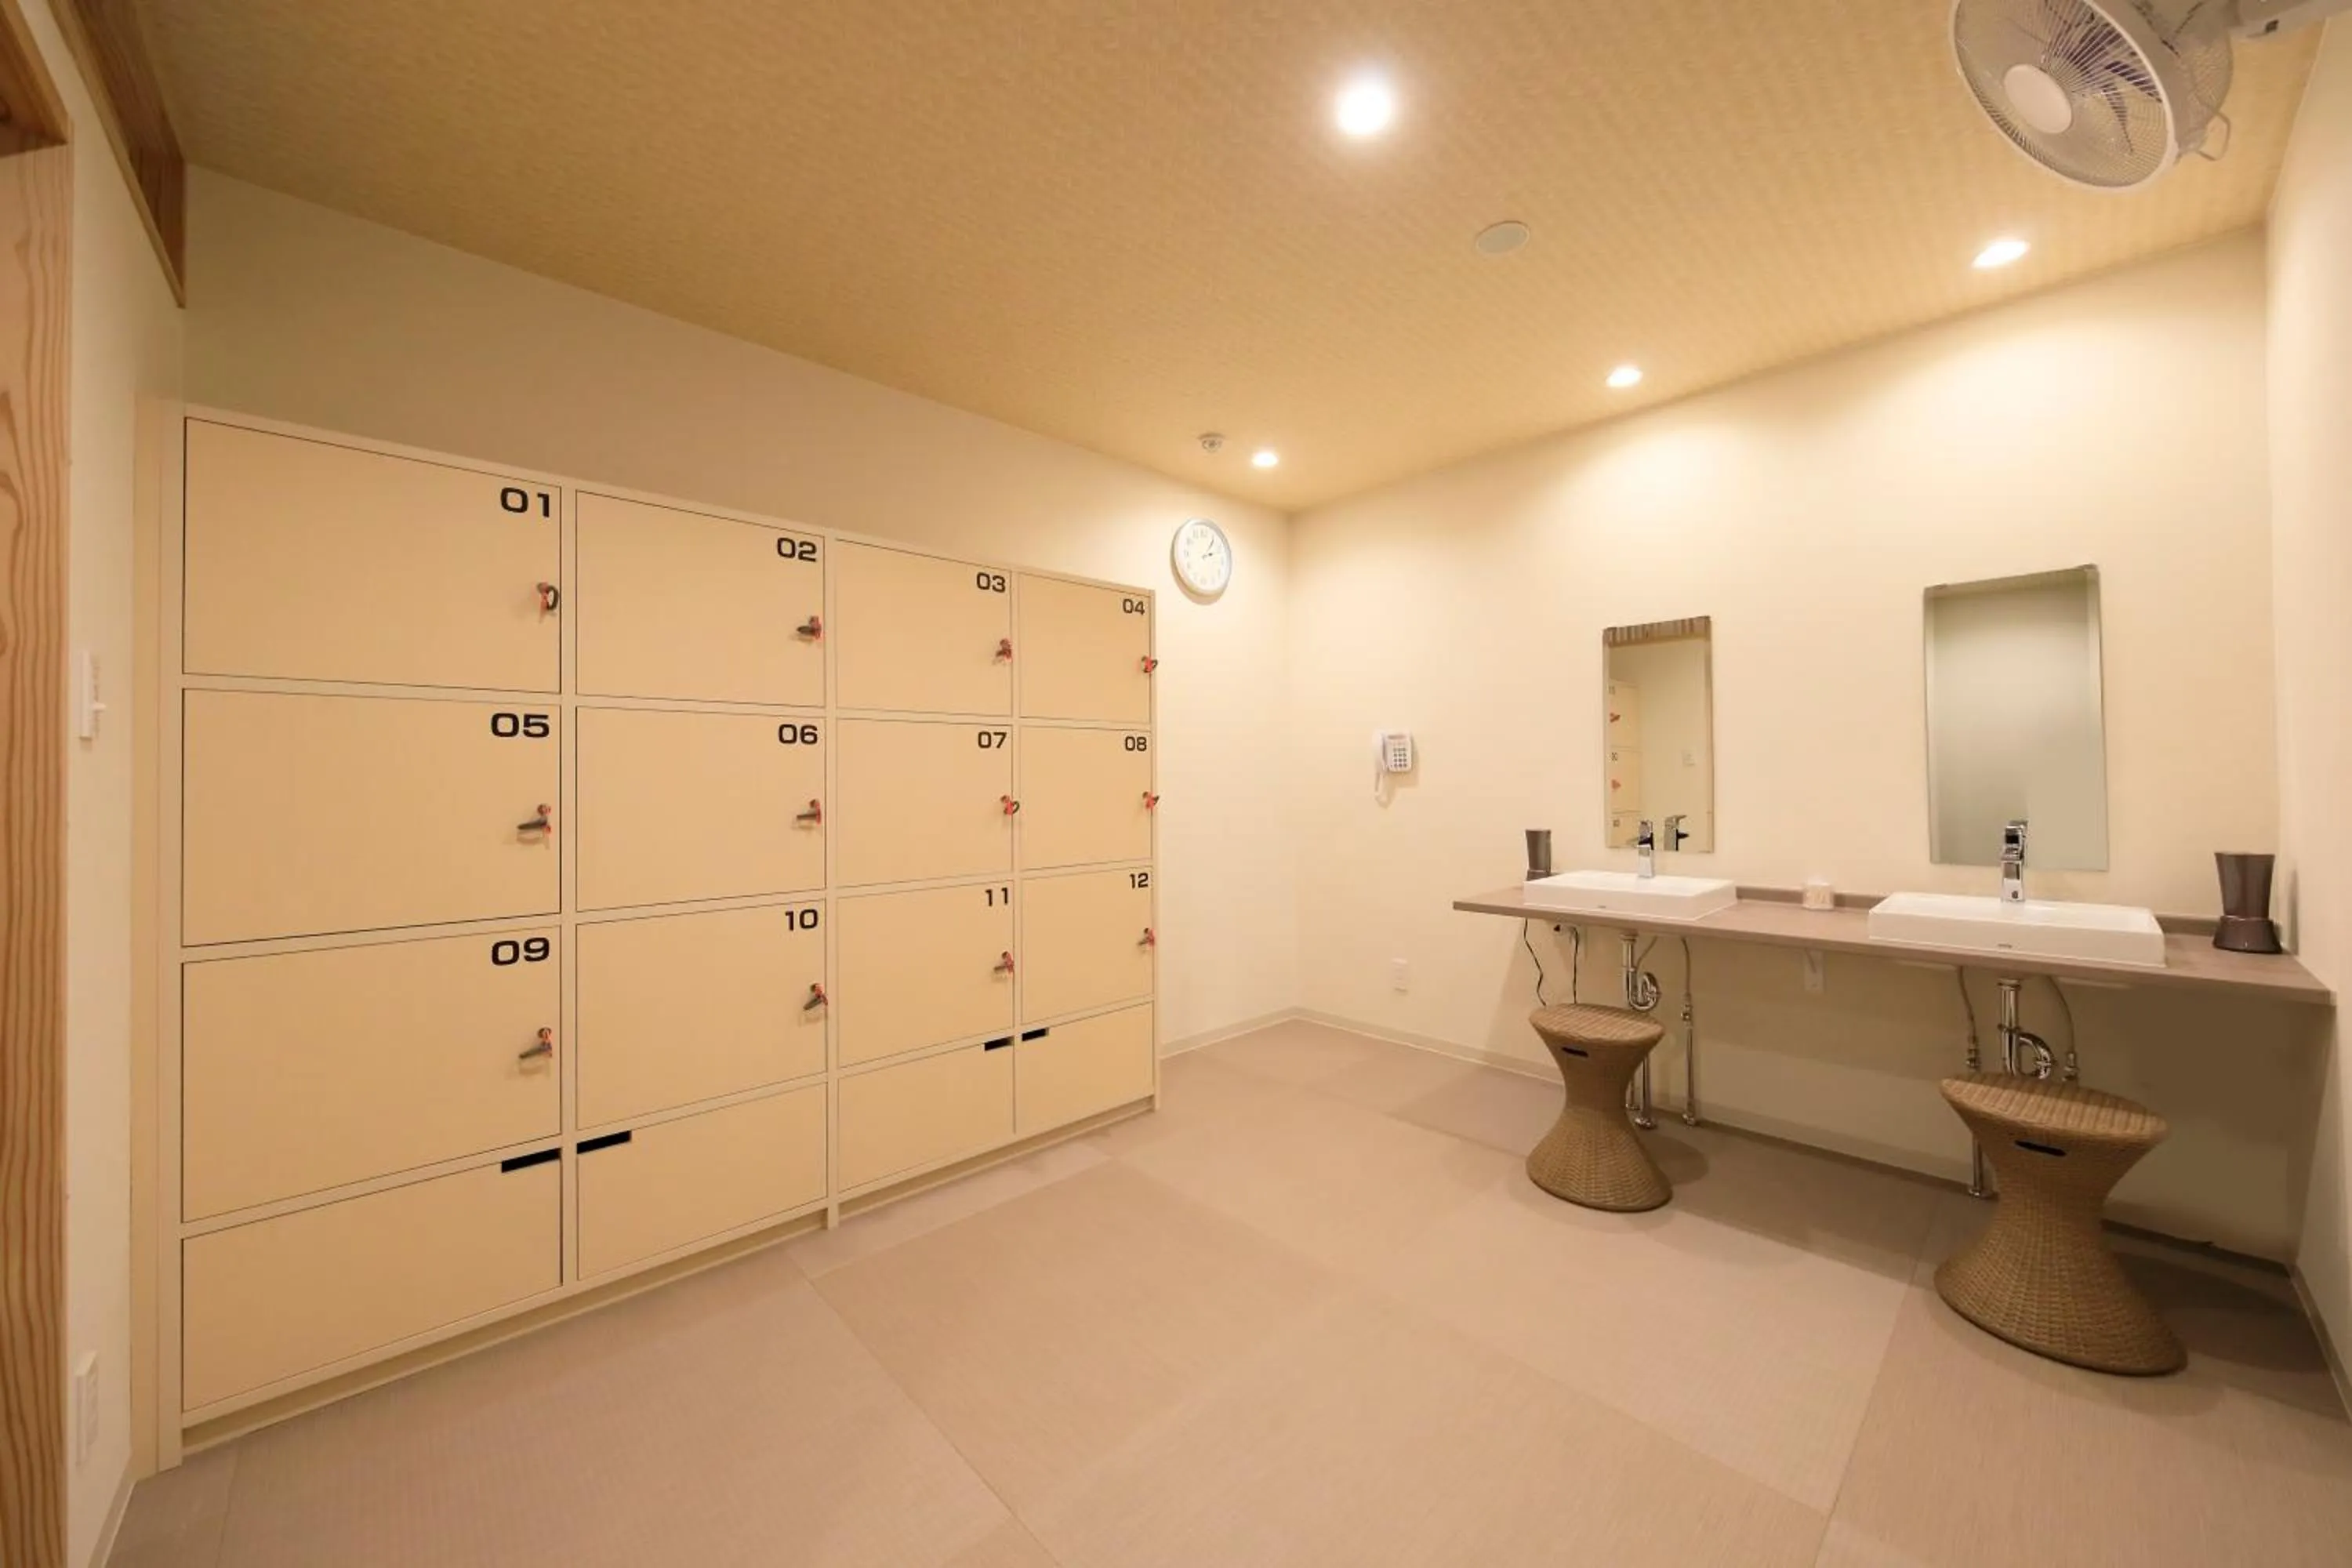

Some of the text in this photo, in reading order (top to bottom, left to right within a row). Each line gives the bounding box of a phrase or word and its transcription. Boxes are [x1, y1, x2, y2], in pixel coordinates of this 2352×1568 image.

[500, 487, 550, 518] 01
[777, 537, 817, 563] 02
[976, 572, 1006, 593] 03
[1122, 598, 1145, 615] 04
[490, 713, 550, 739] 05
[778, 724, 818, 745] 06
[978, 731, 1007, 749] 07
[1124, 735, 1147, 752] 08
[1130, 872, 1149, 889] 12
[985, 887, 1008, 907] 11
[785, 909, 818, 931] 10
[492, 937, 550, 966] 09
